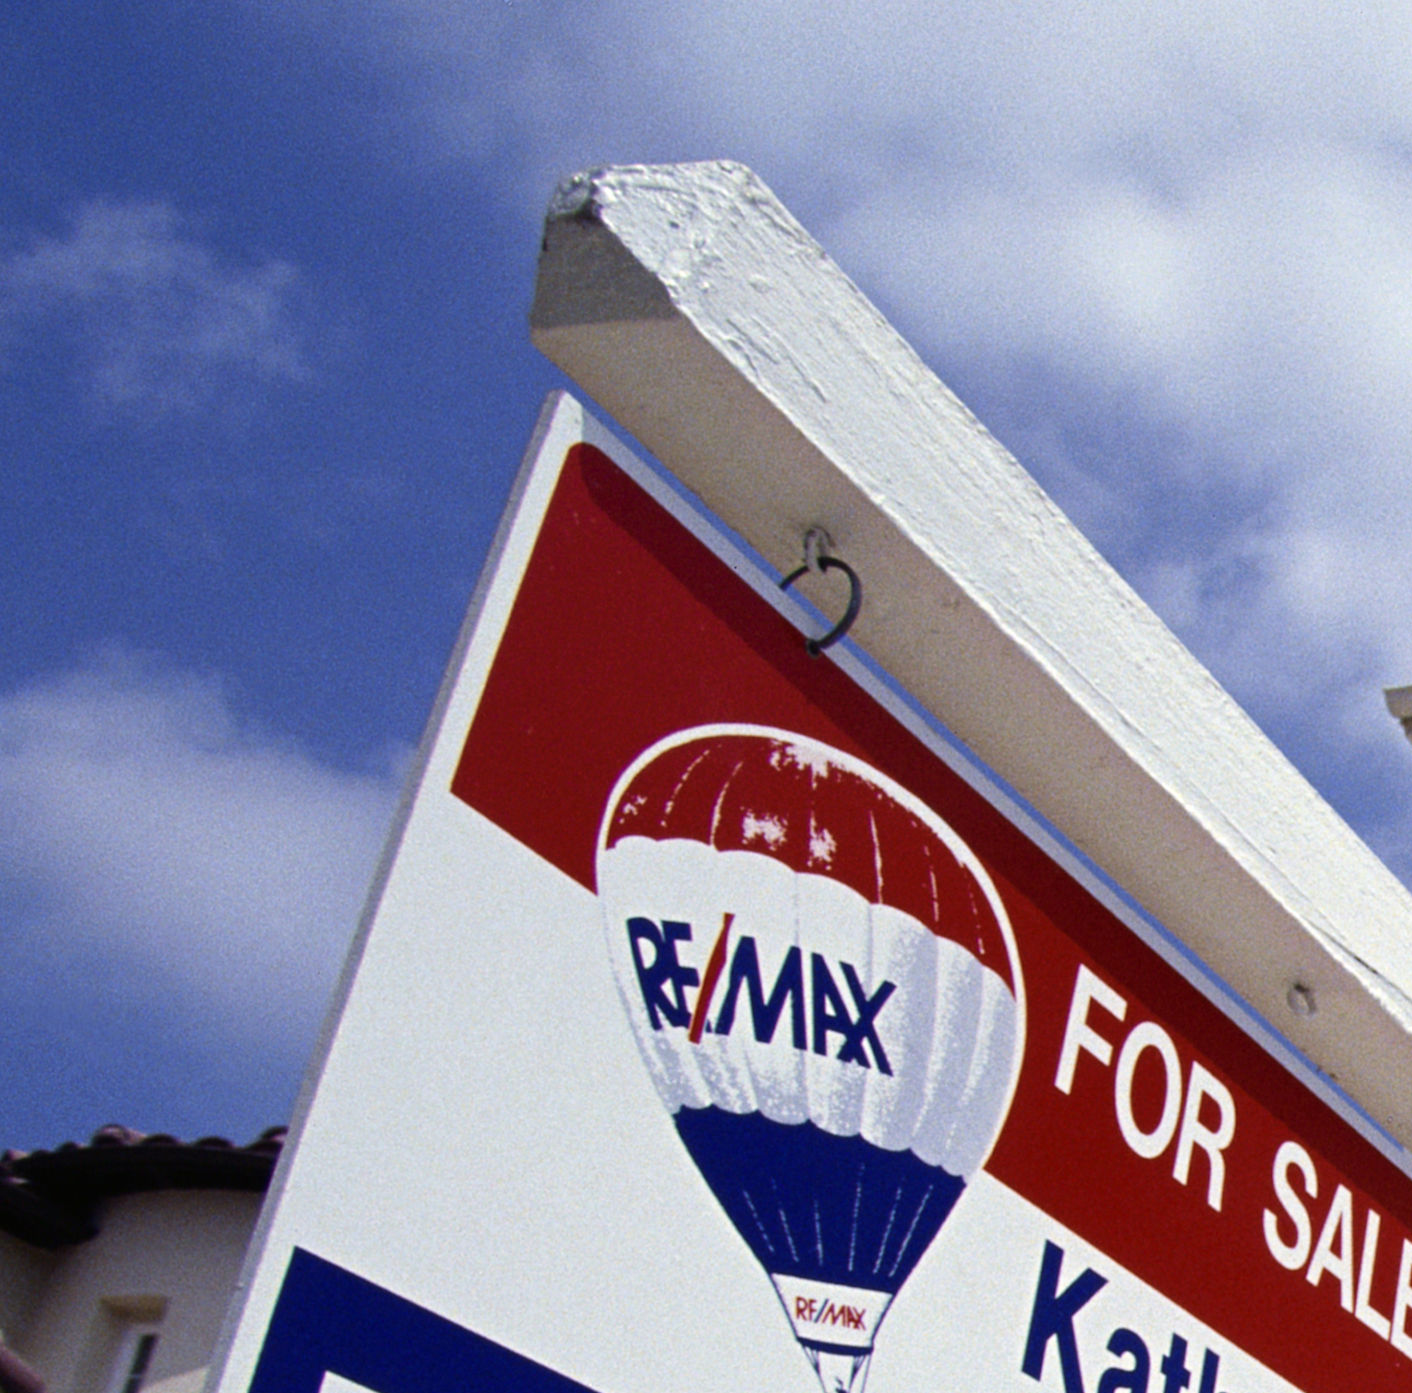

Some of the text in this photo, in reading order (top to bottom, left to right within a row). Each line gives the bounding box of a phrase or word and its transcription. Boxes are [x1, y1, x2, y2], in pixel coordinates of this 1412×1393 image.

[625, 911, 897, 1077] RE/MAX
[1054, 963, 1237, 1213] FOR
[795, 1295, 867, 1331] RE/MAX
